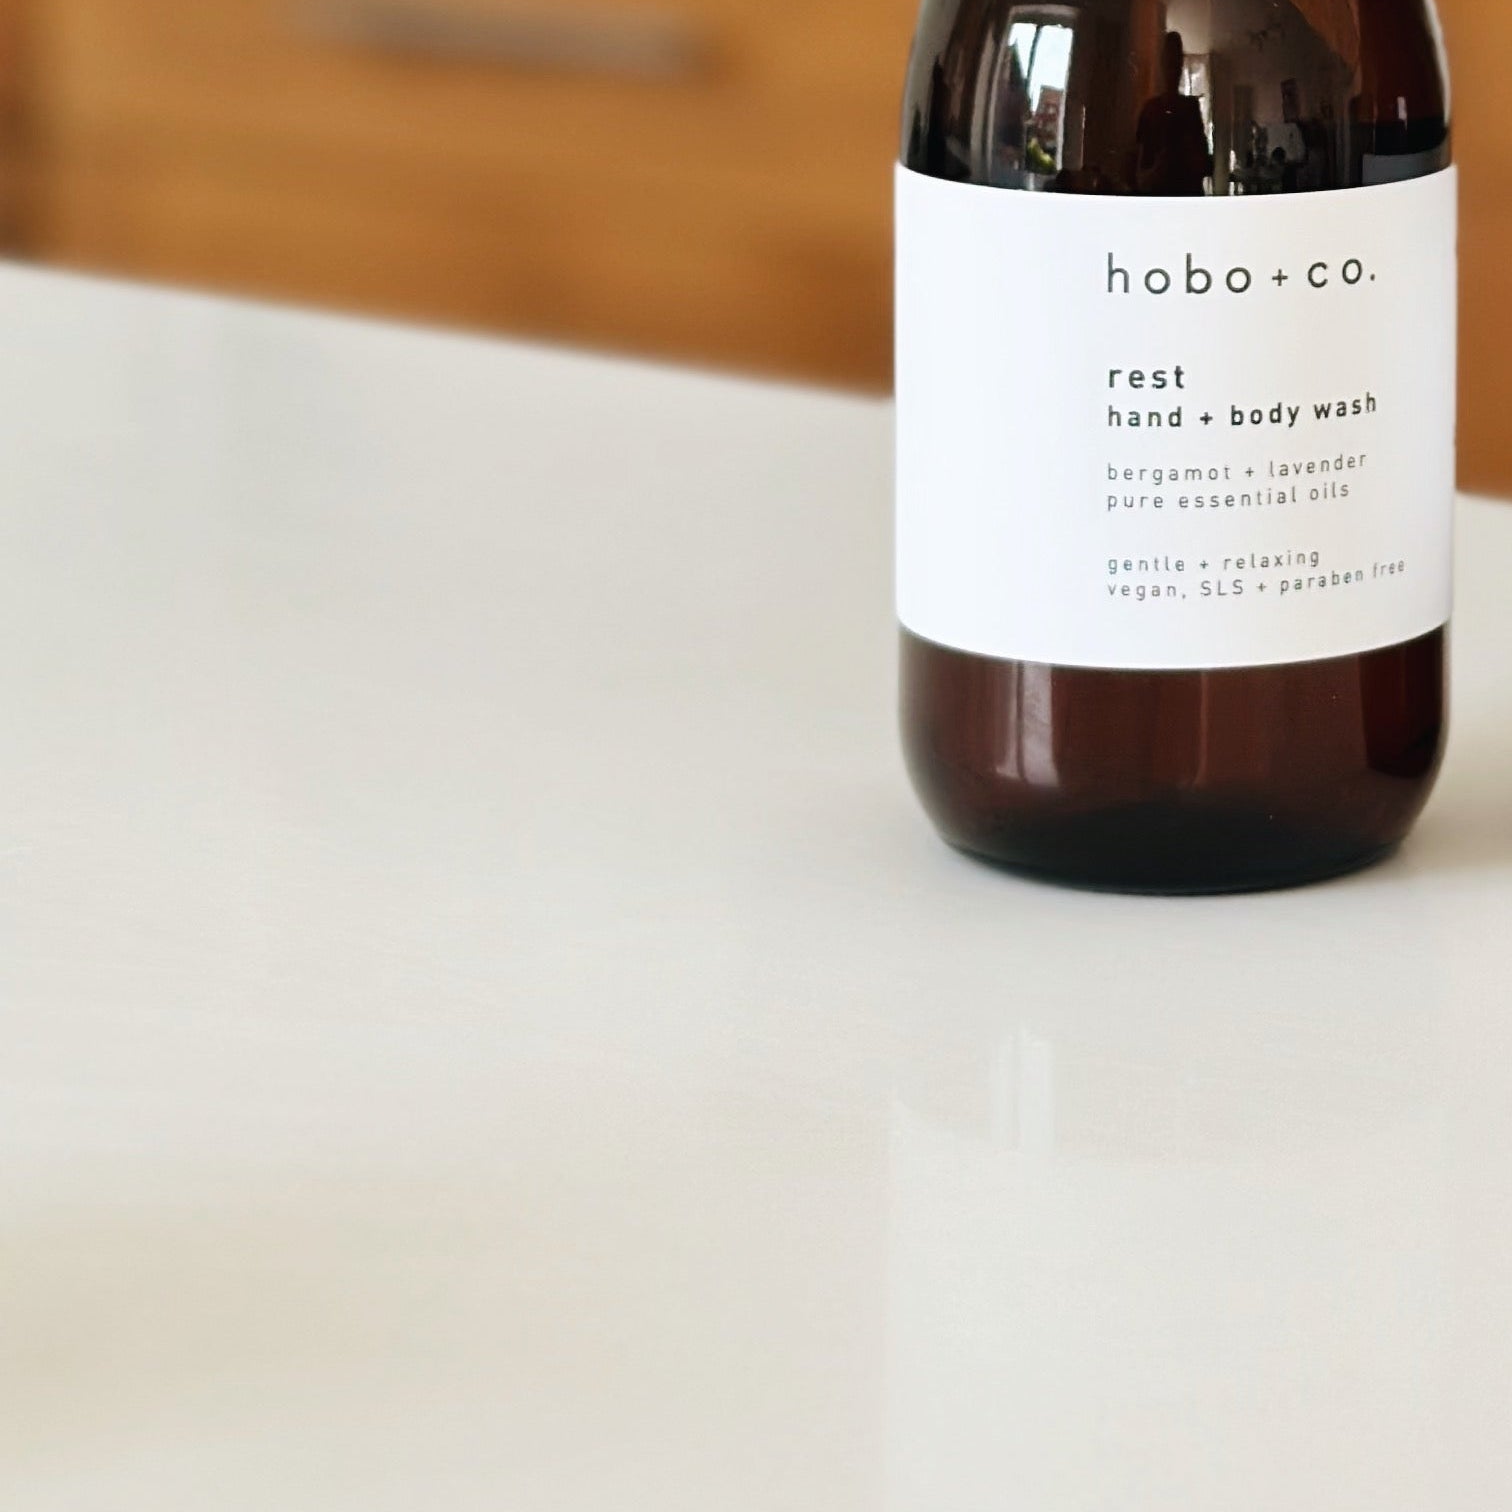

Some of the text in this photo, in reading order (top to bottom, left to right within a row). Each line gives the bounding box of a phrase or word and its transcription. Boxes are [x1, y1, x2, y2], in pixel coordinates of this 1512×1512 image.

[1107, 252, 1376, 295] hobo + co.
[1108, 365, 1185, 390] rest
[1108, 391, 1377, 429] hand + body wash
[1107, 453, 1367, 486] bergamot + lavender
[1107, 481, 1350, 512] pure essential oils
[1107, 551, 1319, 576] gentle + relaxing
[1199, 578, 1244, 597] SLS
[1257, 582, 1267, 593] +
[1280, 570, 1364, 596] paraben
[1372, 560, 1405, 579] free
